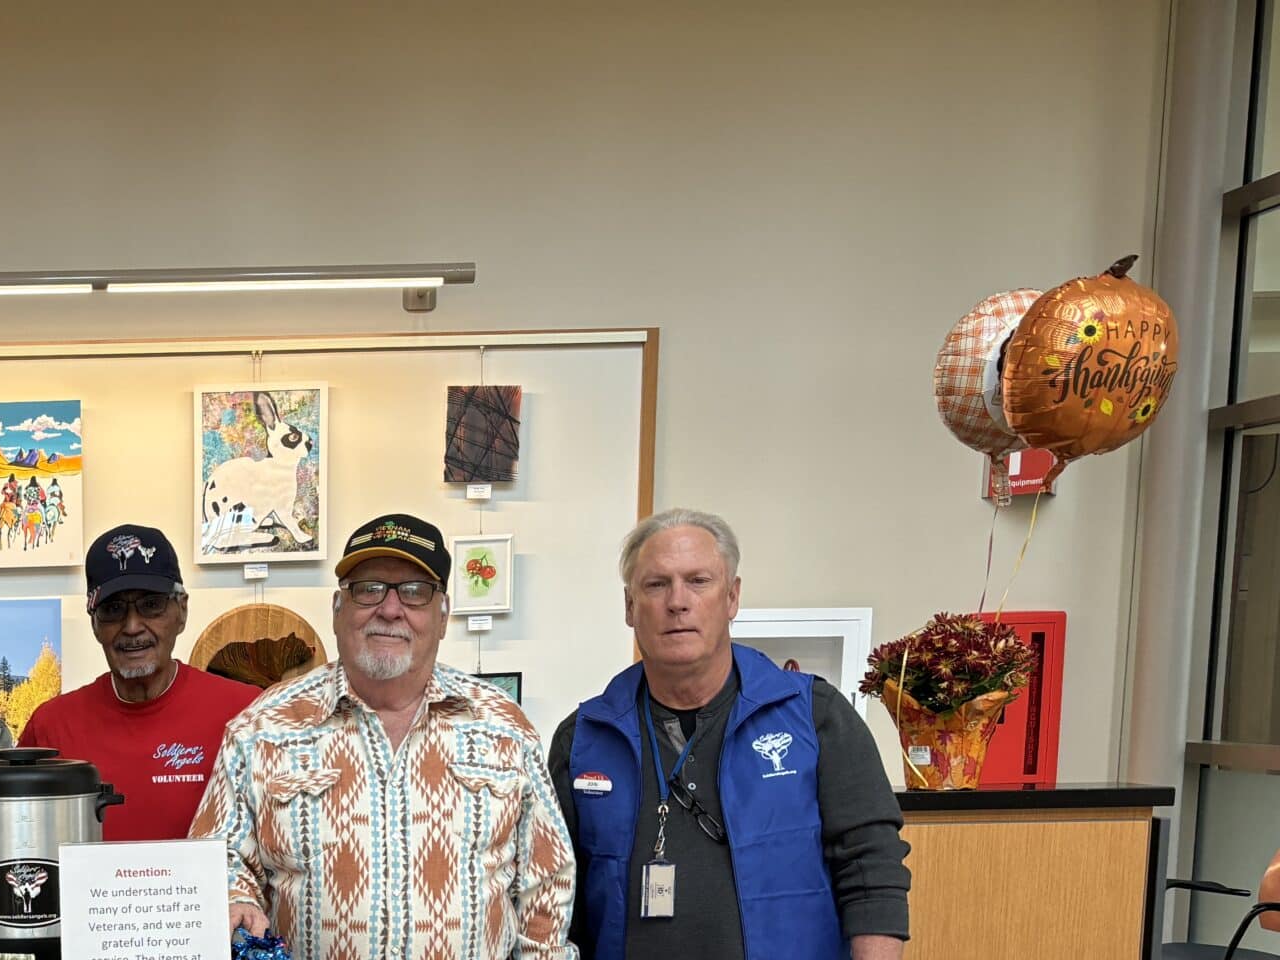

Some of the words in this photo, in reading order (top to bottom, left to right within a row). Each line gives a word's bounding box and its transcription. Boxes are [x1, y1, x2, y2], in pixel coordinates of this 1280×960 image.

[1106, 319, 1170, 341] HAPPY
[1008, 478, 1043, 488] quipment
[151, 774, 205, 783] VOLUNTEER
[115, 867, 171, 879] Attention:
[89, 888, 109, 898] We
[111, 886, 172, 898] understand
[176, 885, 198, 896] that
[89, 906, 117, 917] many
[121, 903, 133, 914] of
[135, 905, 153, 914] our
[156, 901, 180, 913] staff
[183, 904, 201, 912] are
[88, 921, 140, 932] Veterans,
[142, 920, 163, 930] and
[165, 921, 182, 930] we
[184, 920, 202, 929] are
[101, 937, 144, 950] grateful
[147, 937, 163, 947] for
[165, 937, 190, 948] your
